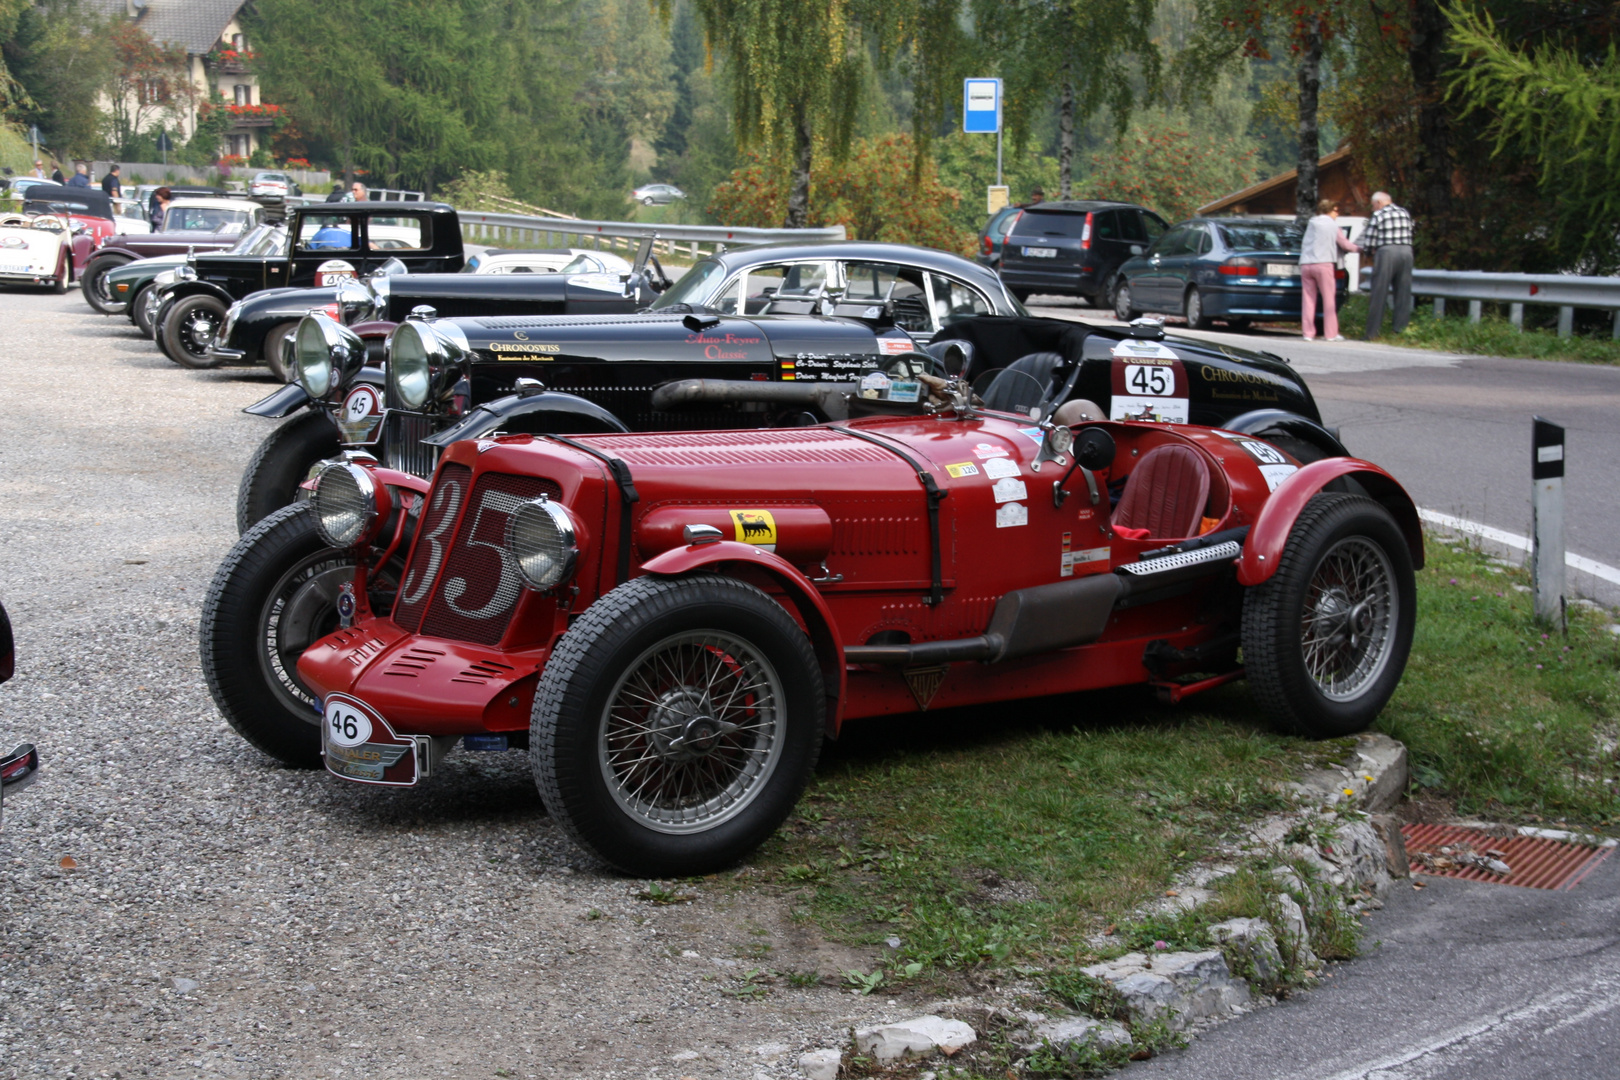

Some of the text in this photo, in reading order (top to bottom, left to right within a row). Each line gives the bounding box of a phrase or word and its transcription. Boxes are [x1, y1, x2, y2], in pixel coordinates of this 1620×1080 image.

[684, 333, 761, 345] Auto-Feyrer
[489, 342, 560, 352] CHRONOSWISS
[704, 345, 748, 359] Classic
[1131, 366, 1166, 395] 45
[351, 397, 367, 414] 45
[962, 465, 977, 474] 120
[332, 710, 358, 739] 46
